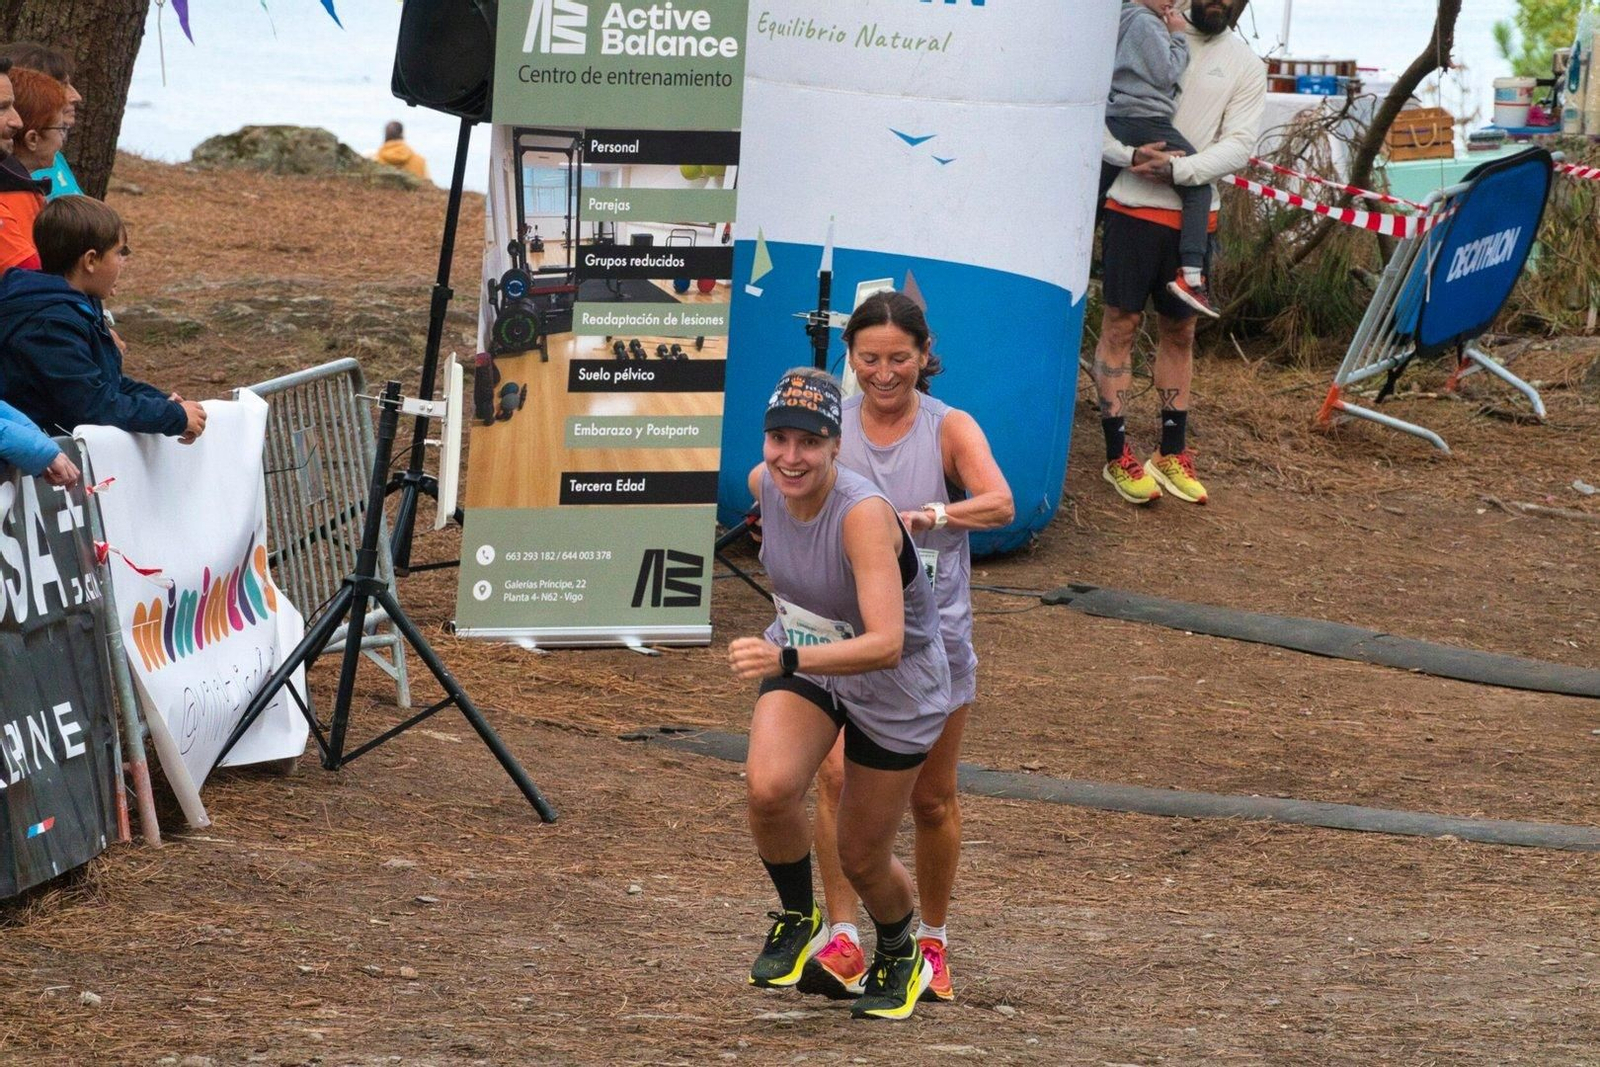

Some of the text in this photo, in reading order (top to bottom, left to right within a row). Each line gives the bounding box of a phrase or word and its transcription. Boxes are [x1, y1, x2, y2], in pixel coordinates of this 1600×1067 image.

[601, 2, 711, 30] Active
[757, 11, 953, 53] Equilibrio Natural
[600, 28, 739, 58] Balance
[518, 65, 733, 87] Centro de entrenamiento
[590, 139, 640, 154] Personal
[588, 197, 631, 215] Parejas
[584, 253, 685, 270] Grupos reducidos
[1446, 226, 1522, 283] DECATHLON
[582, 312, 724, 328] Readaptación de lesiones
[578, 367, 655, 384] Suelo pélvico
[574, 423, 700, 439] Embarazo y Postparto
[569, 478, 646, 493] Tercera Edad
[505, 551, 521, 561] 663
[523, 551, 538, 561] 293
[540, 551, 556, 560] 182
[562, 551, 578, 560] 644
[579, 551, 595, 560] 003
[596, 550, 612, 560] 378
[504, 579, 587, 590] Galerías Príncipe, 22
[503, 592, 530, 602] Planta
[541, 592, 558, 601] N62
[564, 592, 584, 603] Vigo
[0, 701, 86, 788] LPINE
